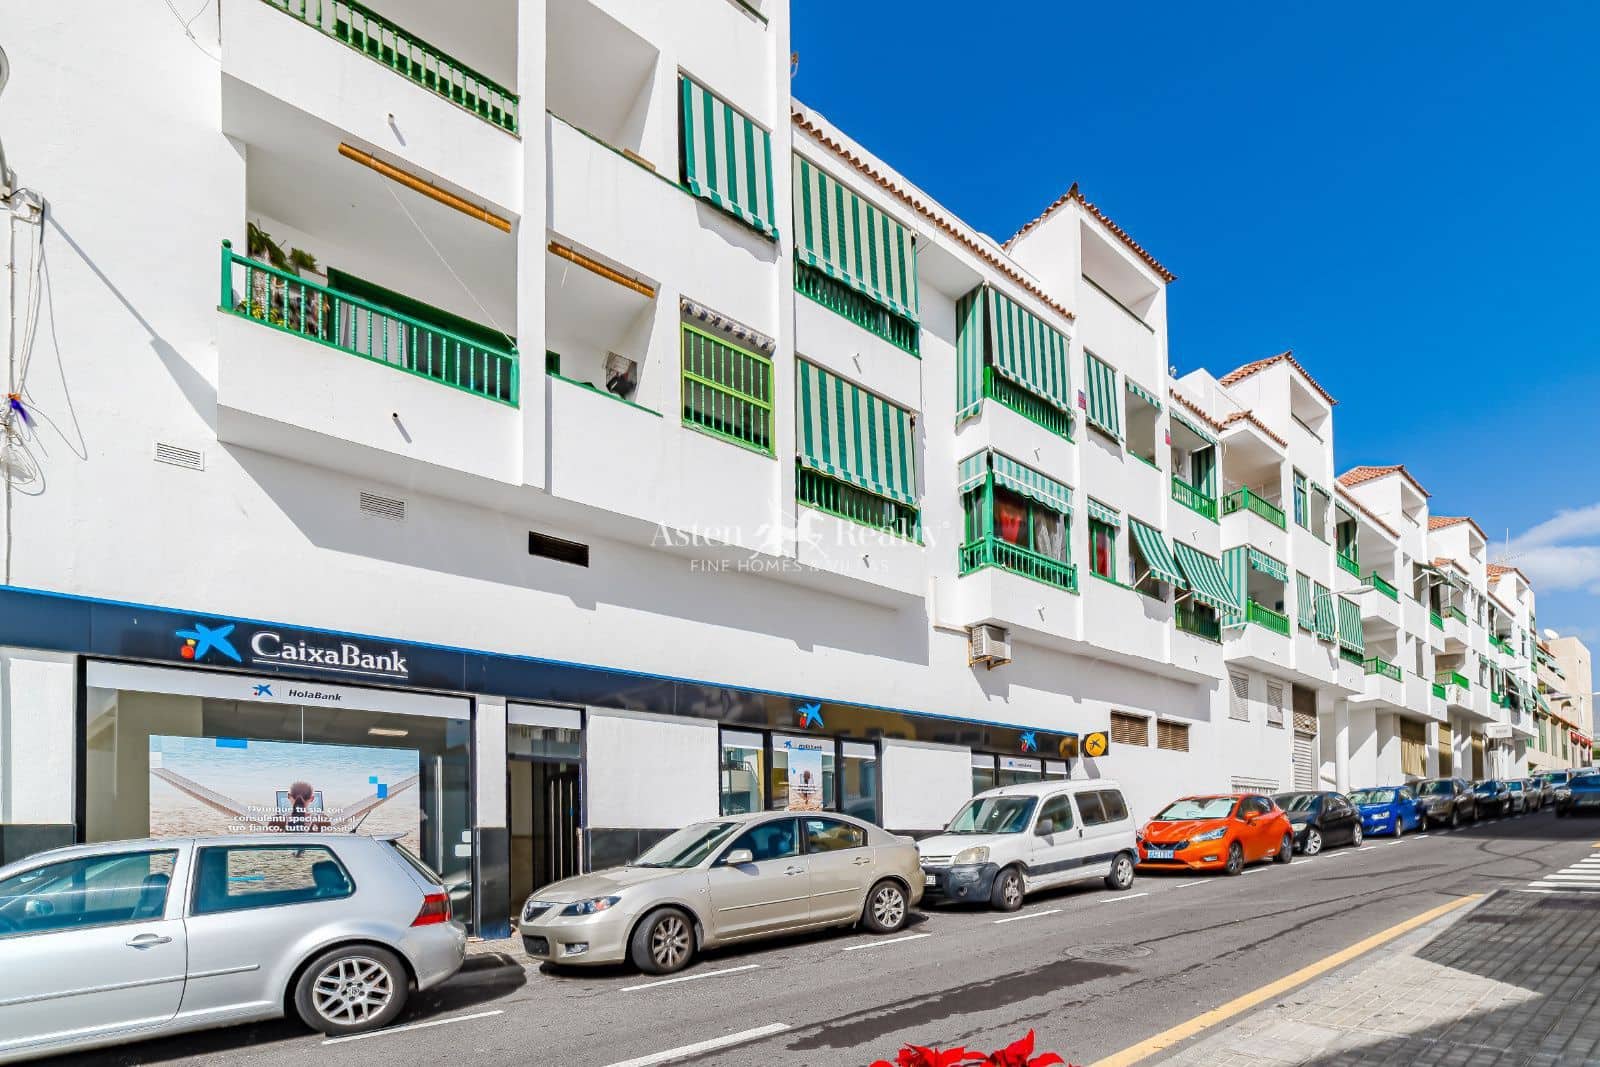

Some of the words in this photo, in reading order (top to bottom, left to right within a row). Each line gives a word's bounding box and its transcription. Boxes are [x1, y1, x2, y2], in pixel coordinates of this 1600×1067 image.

[251, 631, 408, 673] CaixaBank
[288, 689, 342, 701] HolaBank
[286, 824, 310, 832] tutto
